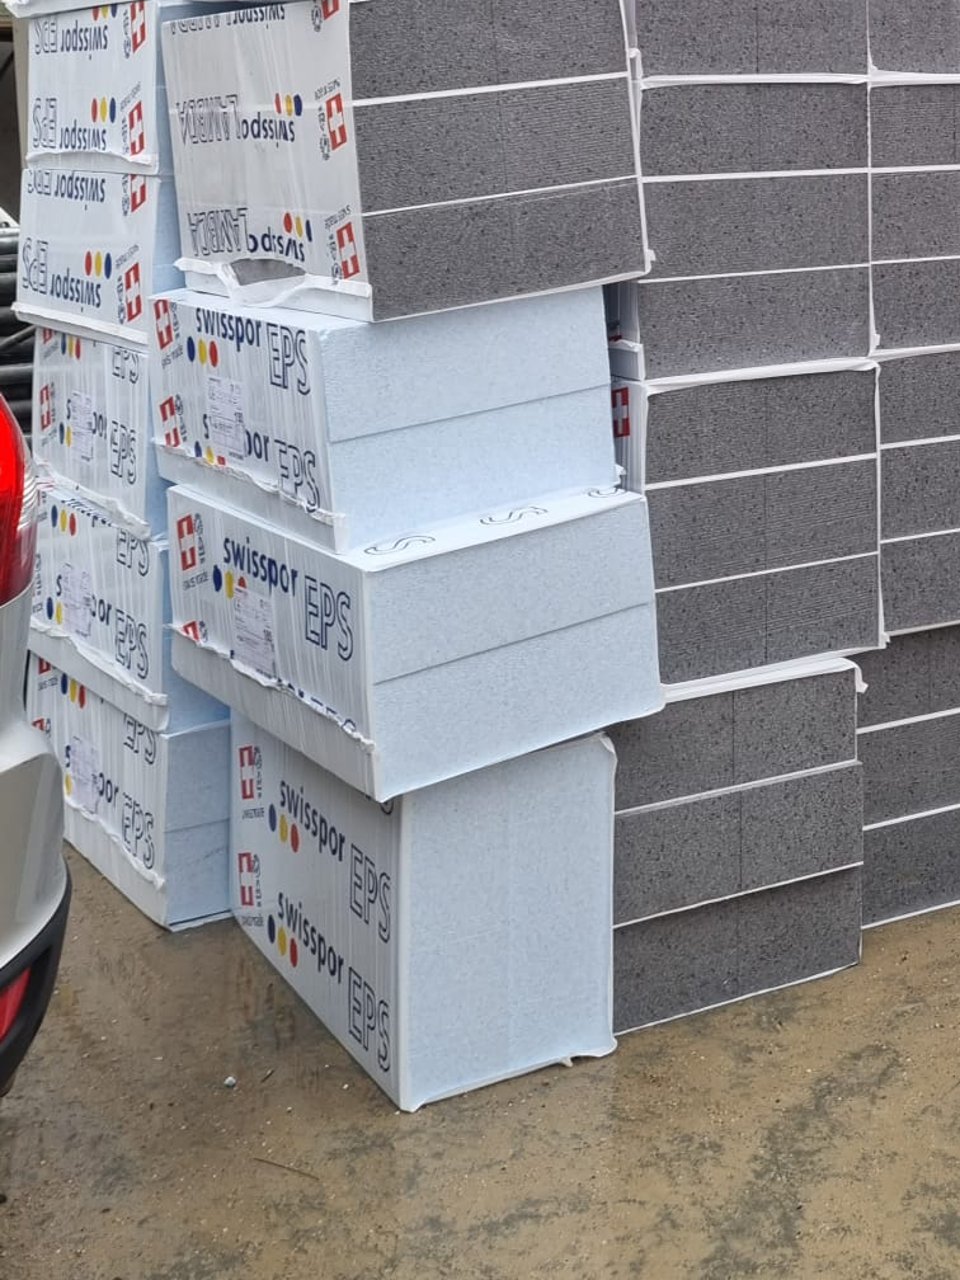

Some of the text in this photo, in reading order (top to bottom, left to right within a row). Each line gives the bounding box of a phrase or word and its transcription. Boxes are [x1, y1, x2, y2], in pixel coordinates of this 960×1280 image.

[61, 21, 108, 60] swisspor
[60, 119, 107, 151] swisspor
[54, 171, 106, 211] swisspor
[50, 267, 102, 313] swisspor
[196, 308, 311, 396] swisspor EPS
[274, 439, 321, 514] EPS
[223, 535, 299, 597] swisspor
[304, 574, 354, 662] EPS
[280, 779, 345, 862] swisspor
[350, 842, 392, 944] EPS
[277, 892, 391, 1073] swisspor EPS
